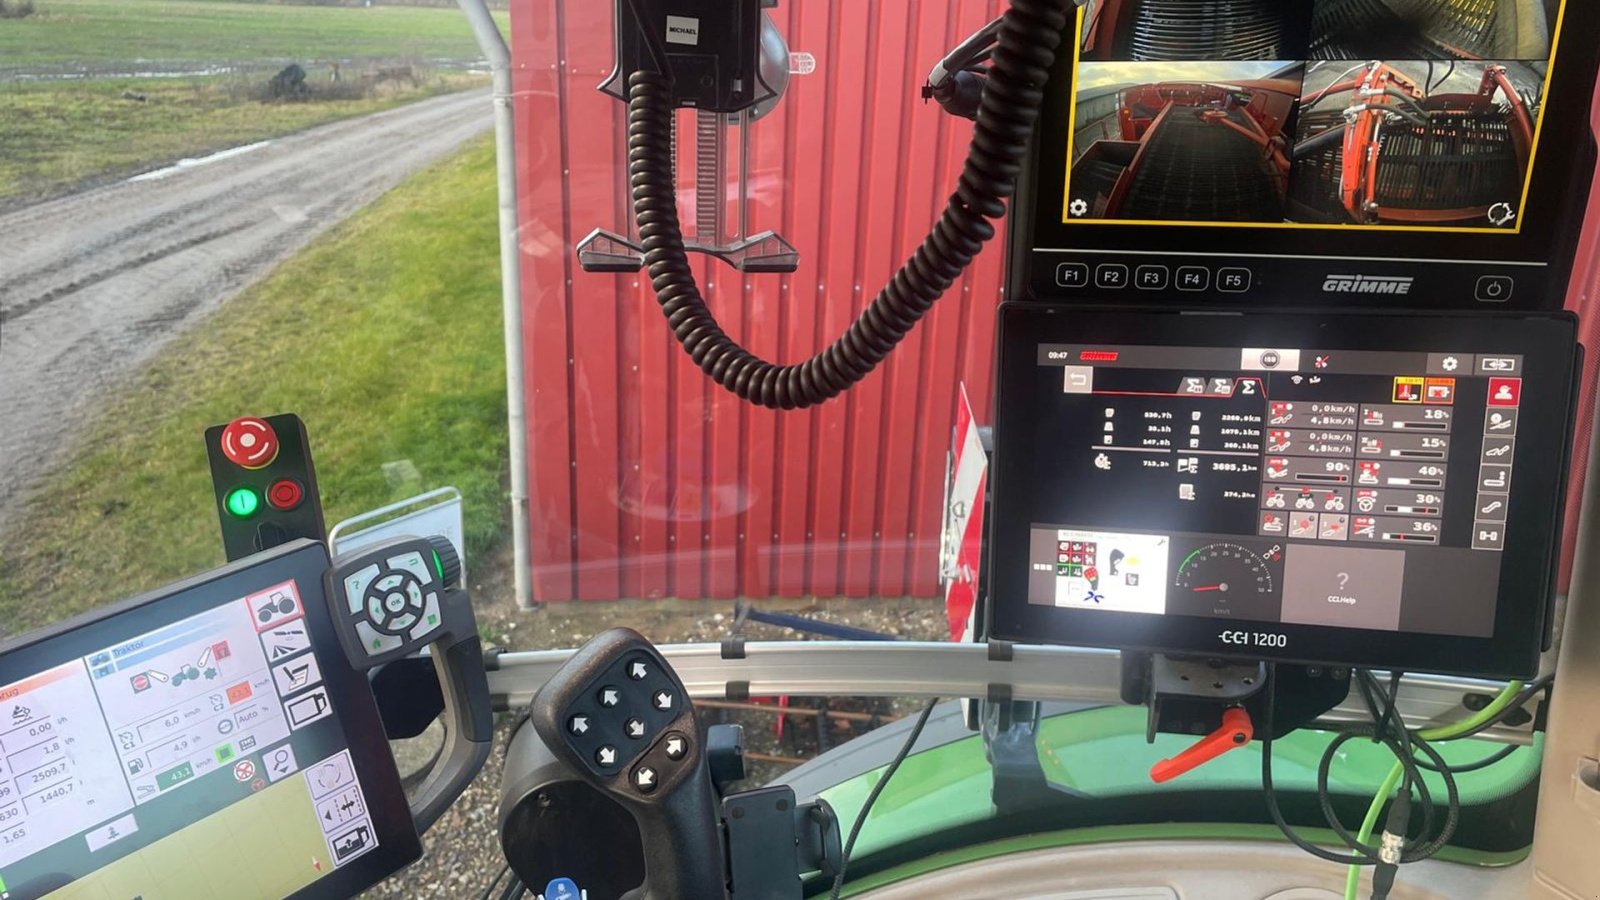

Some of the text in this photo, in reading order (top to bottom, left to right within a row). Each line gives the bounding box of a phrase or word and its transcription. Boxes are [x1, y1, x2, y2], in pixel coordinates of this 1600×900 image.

[669, 27, 697, 35] MICHAEL
[1064, 269, 1079, 281] F1
[1104, 271, 1119, 282] F2
[1144, 272, 1159, 283] F3
[1184, 273, 1200, 284] F4
[1225, 274, 1241, 286] F5
[1322, 274, 1414, 295] GRIMME
[1048, 351, 1068, 359] 09:47
[1424, 409, 1449, 419] 18%
[1421, 438, 1446, 448] 15%
[1325, 462, 1350, 472] 90%
[1418, 466, 1444, 476] 40%
[1416, 494, 1441, 504] 30%
[1413, 522, 1438, 532] 36%
[1253, 633, 1287, 648] 1200
[111, 641, 145, 657] Traktor
[0, 688, 19, 701] rug
[239, 710, 258, 723] Auto
